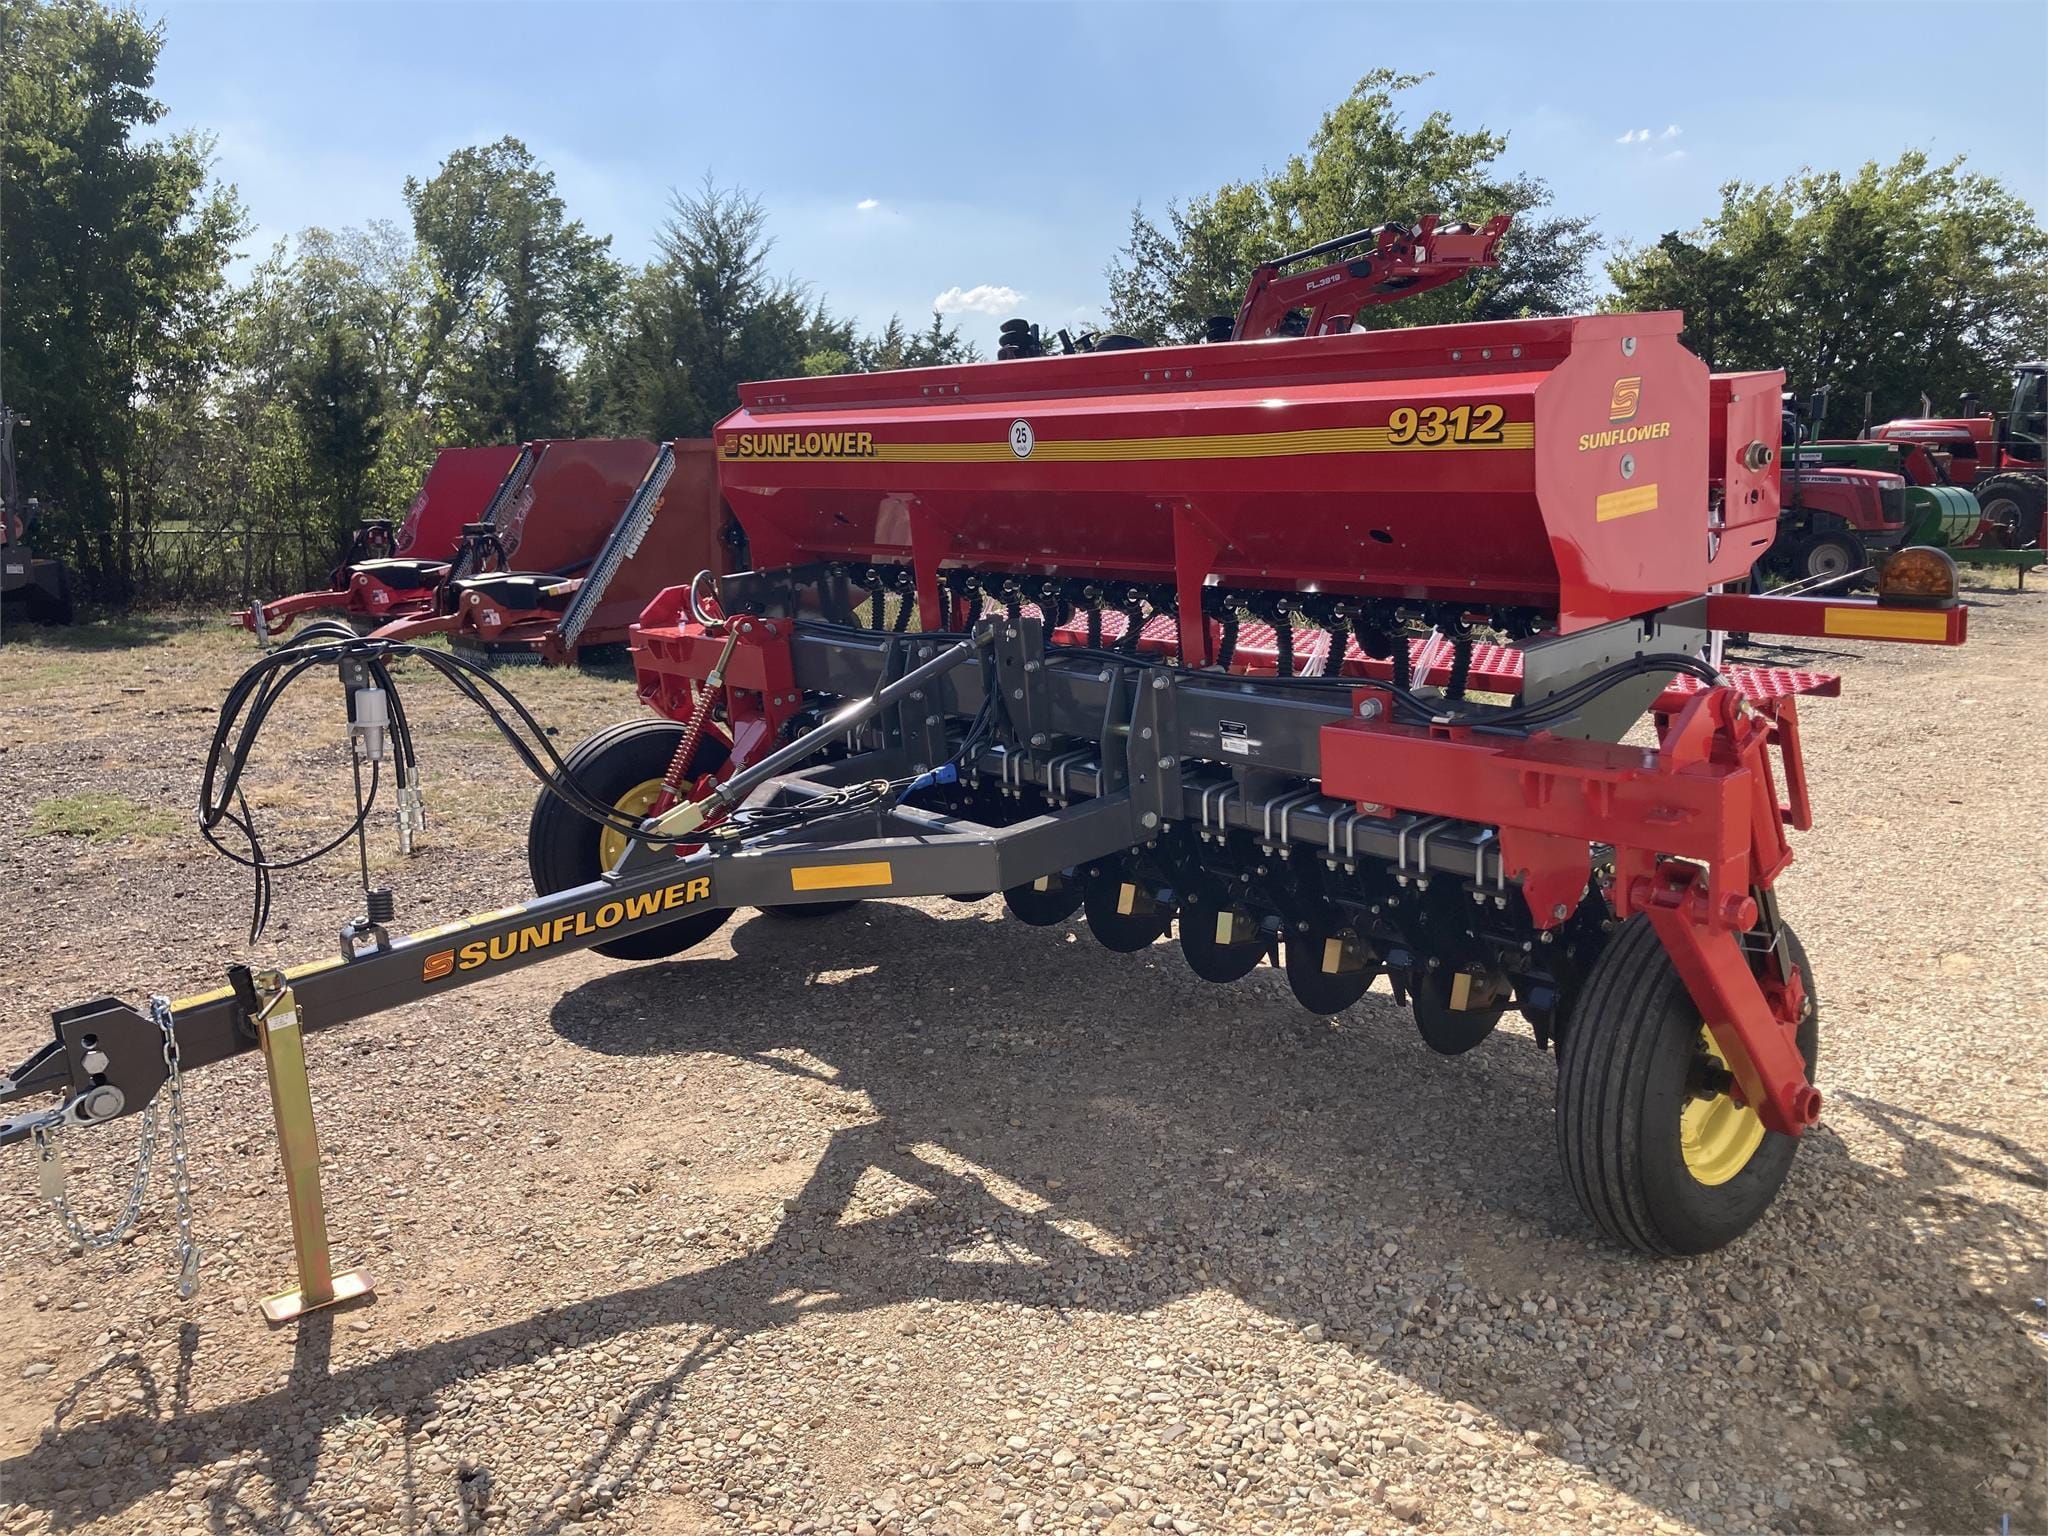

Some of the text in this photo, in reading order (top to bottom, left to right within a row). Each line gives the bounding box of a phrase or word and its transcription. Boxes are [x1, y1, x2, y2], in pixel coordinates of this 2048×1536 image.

[1015, 427, 1027, 444] 25
[1387, 403, 1505, 444] 9312
[1578, 422, 1671, 452] SUNFLOWER
[739, 431, 876, 458] SUNFLOWER
[458, 876, 711, 971] SUNFLOWER
